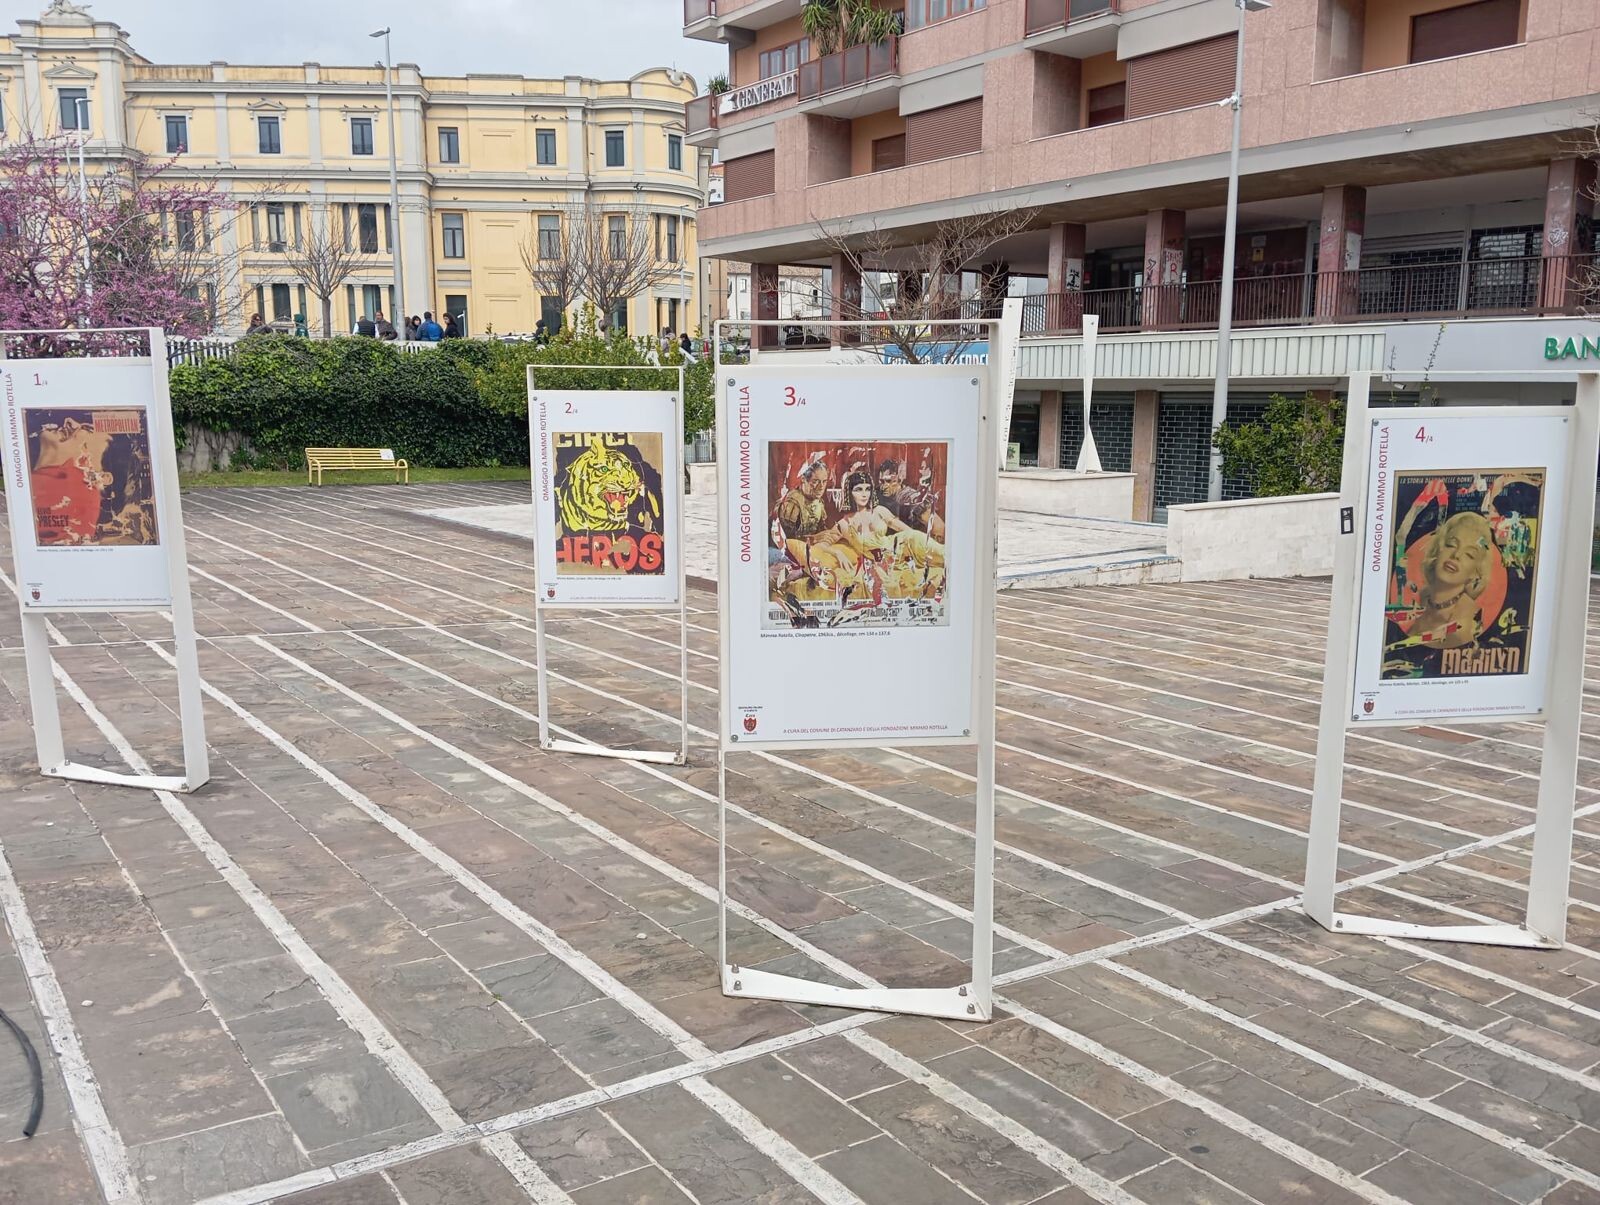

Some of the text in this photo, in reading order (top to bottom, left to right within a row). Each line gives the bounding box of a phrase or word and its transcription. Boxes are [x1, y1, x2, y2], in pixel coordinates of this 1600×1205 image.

[738, 74, 797, 108] GENERALI
[5, 373, 14, 406] ROTELLA
[8, 408, 18, 441] MIMMO
[13, 449, 24, 488] OMAGGIO
[739, 386, 750, 562] OMAGGIO A MIMMO ROTELLA
[1372, 427, 1389, 572] OMAGGIO A MIMMO ROTELLA
